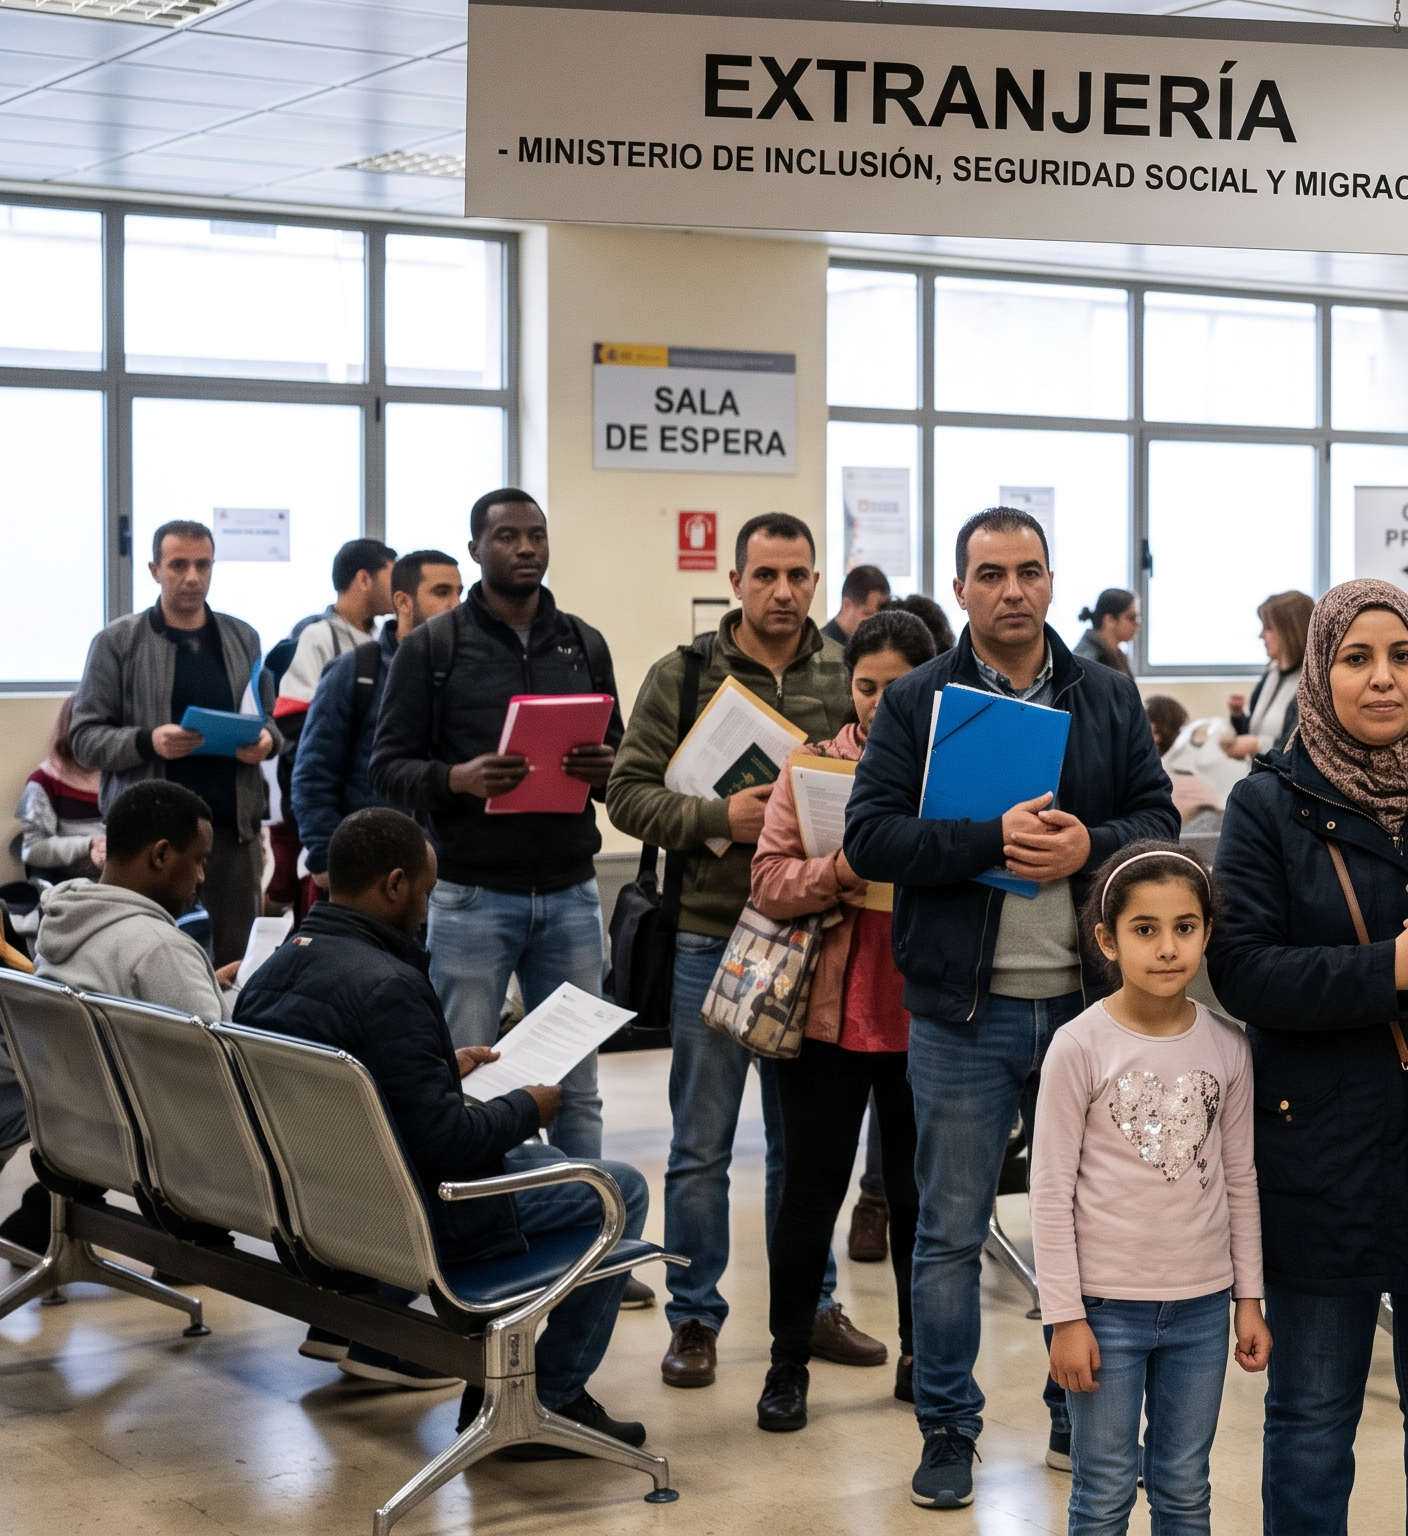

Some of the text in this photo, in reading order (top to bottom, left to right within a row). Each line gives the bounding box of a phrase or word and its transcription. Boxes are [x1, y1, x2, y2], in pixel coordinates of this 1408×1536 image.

[704, 53, 1297, 144] EXTRANJERÍA
[518, 136, 704, 171] MINISTERIO
[713, 144, 754, 172] DE
[765, 141, 943, 185] INCLUSIÓN,
[953, 155, 1135, 189] SEGURIDAD
[1145, 164, 1258, 194] SOCIAL
[1267, 169, 1286, 194] Y
[653, 385, 740, 418] SALA
[605, 423, 787, 457] DE ESPERA
